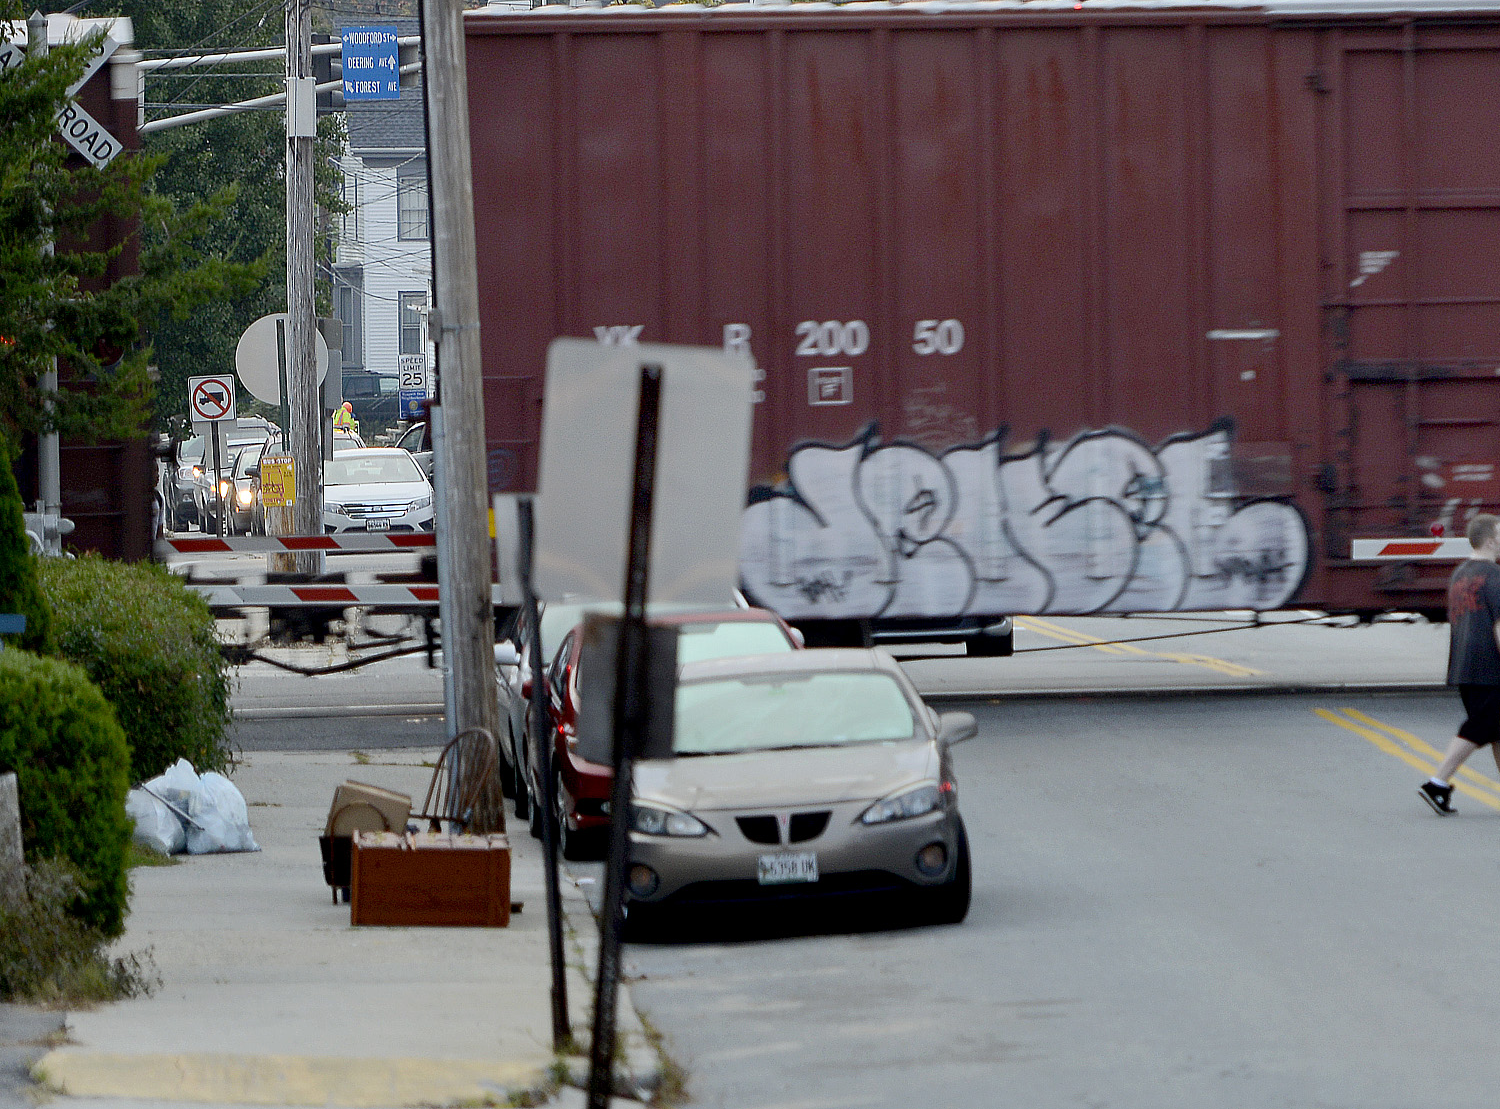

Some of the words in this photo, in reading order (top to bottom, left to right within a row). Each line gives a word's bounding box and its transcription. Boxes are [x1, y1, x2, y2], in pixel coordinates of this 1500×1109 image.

[348, 31, 382, 44] WOODFORD
[382, 32, 391, 43] ST
[347, 56, 374, 69] DEERING
[378, 57, 388, 67] AVE
[355, 81, 380, 94] FOREST
[387, 81, 397, 91] AVE
[57, 106, 113, 160] ROAD
[795, 320, 870, 356] 200
[912, 318, 965, 355] 50
[402, 372, 423, 386] 25
